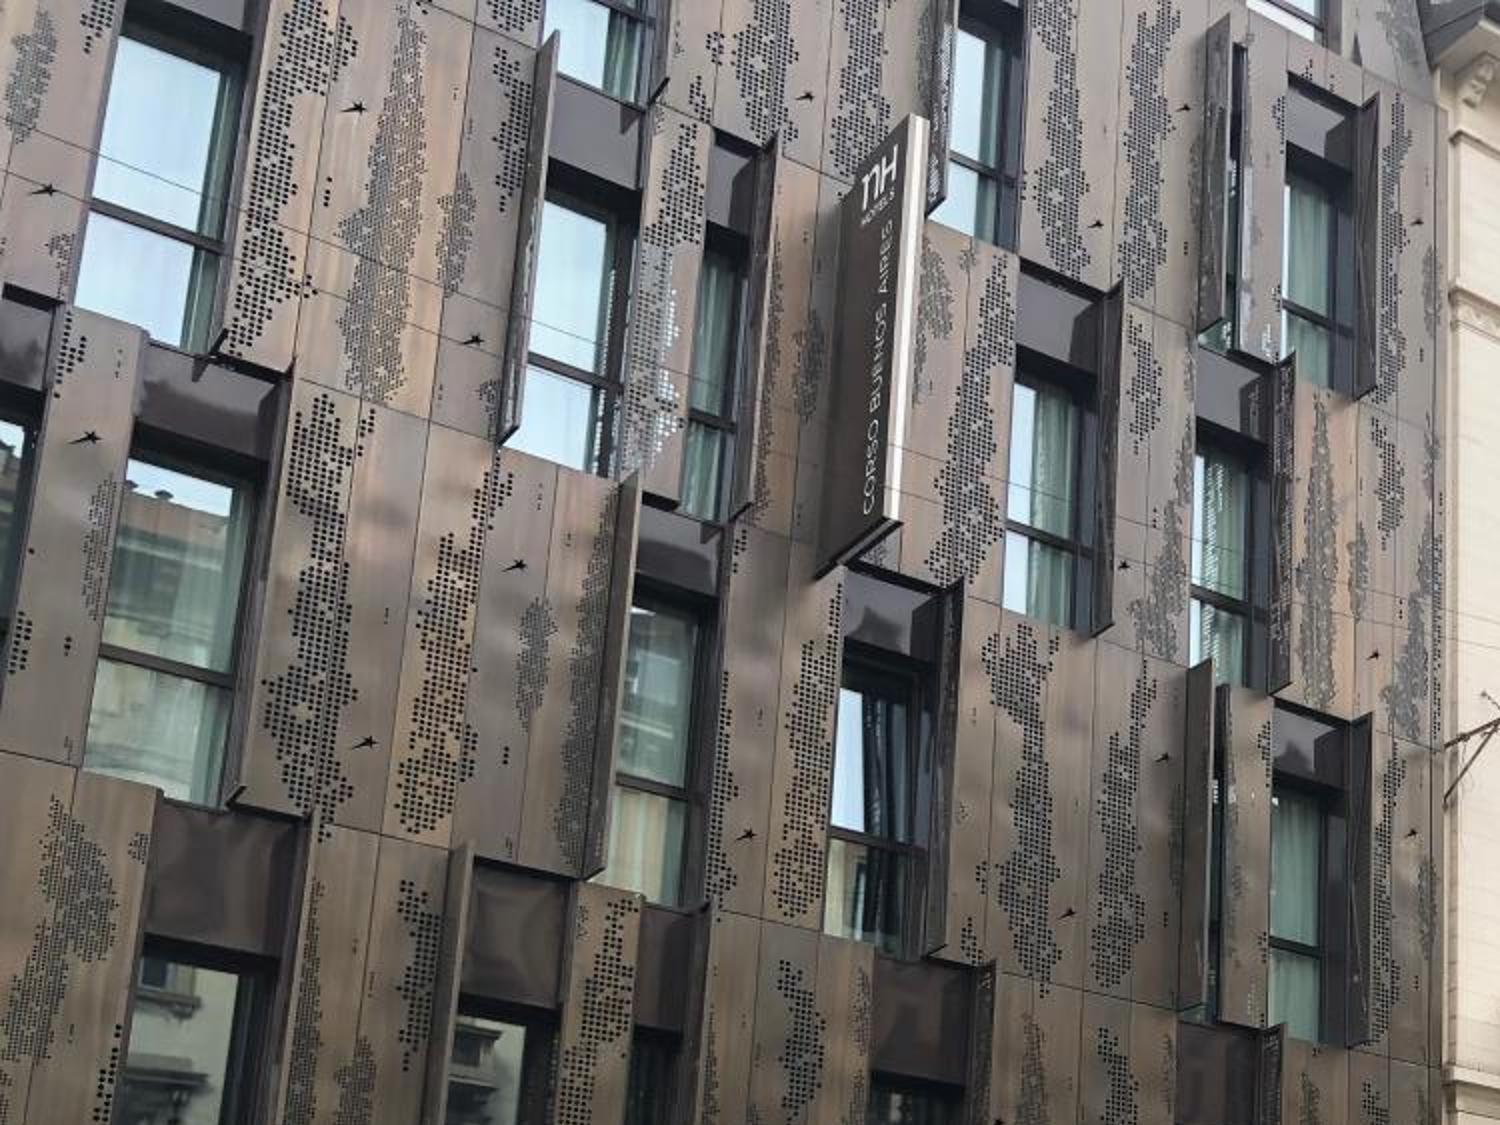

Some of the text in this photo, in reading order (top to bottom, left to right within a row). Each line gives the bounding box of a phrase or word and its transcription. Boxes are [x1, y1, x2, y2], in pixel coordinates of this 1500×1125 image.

[863, 218, 893, 515] CORSO BUENOS AIRES
